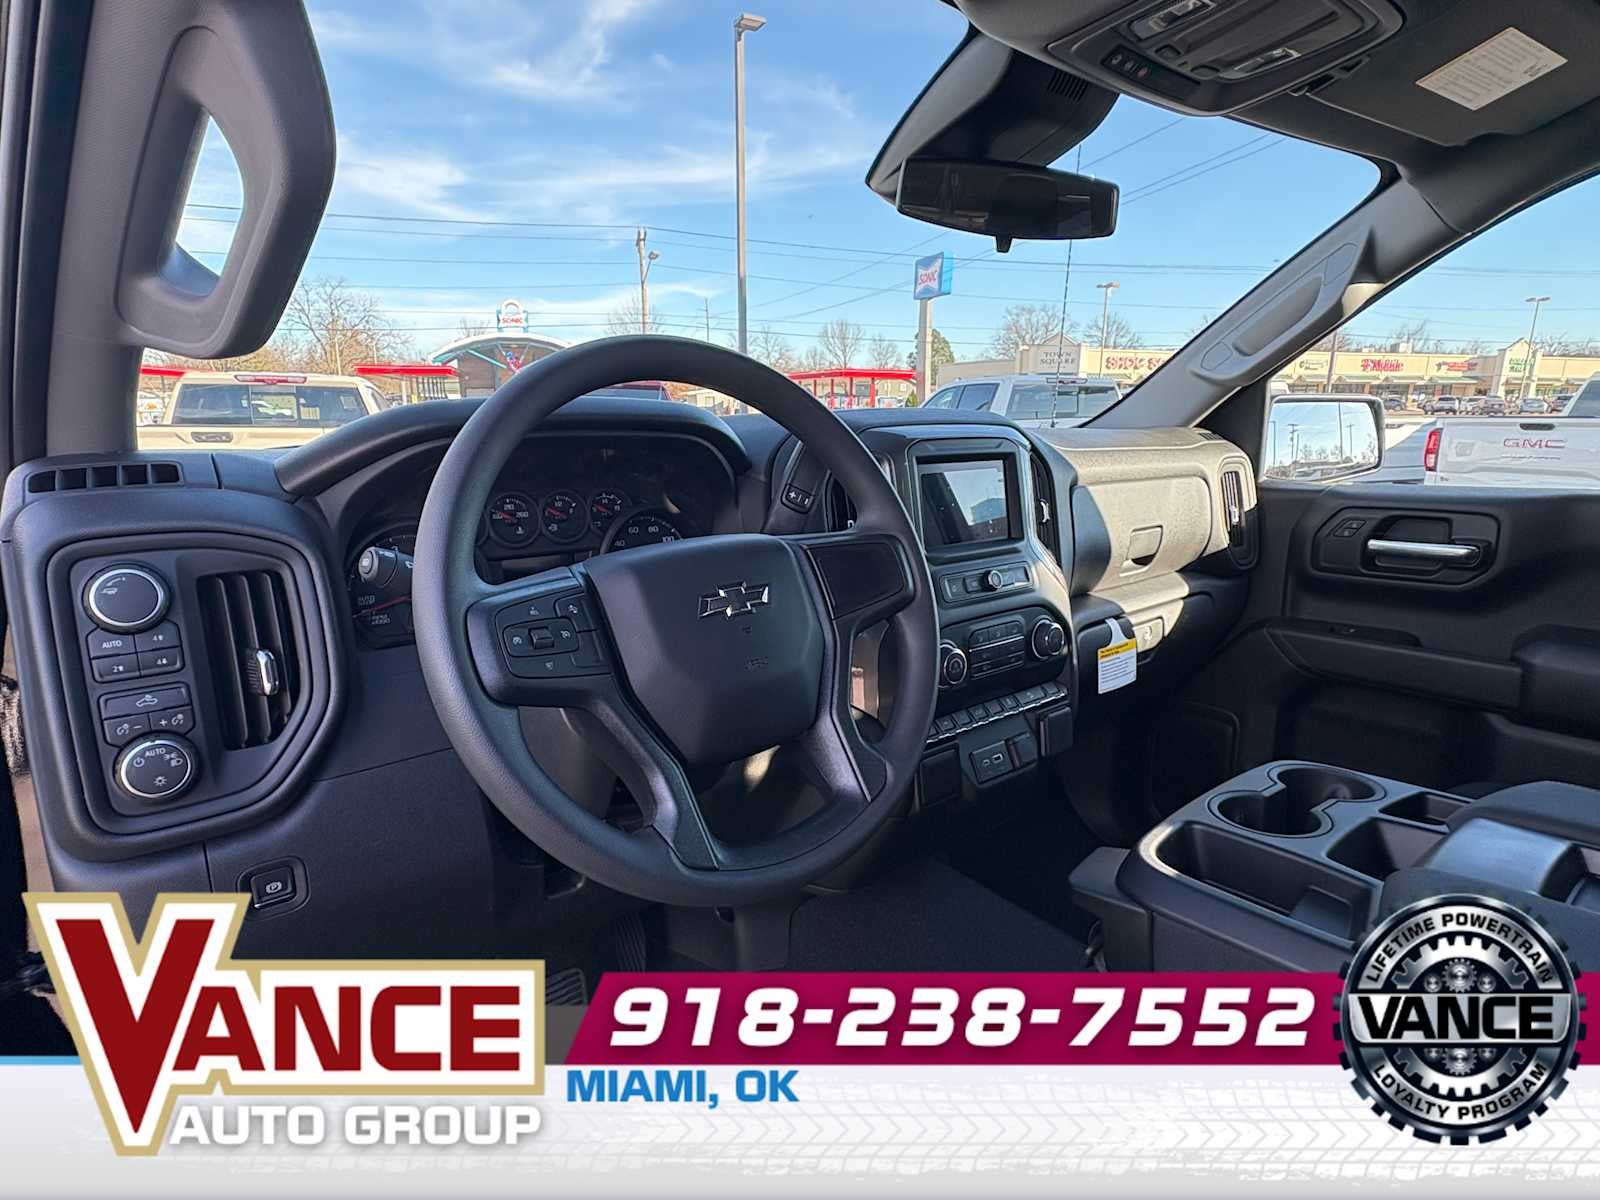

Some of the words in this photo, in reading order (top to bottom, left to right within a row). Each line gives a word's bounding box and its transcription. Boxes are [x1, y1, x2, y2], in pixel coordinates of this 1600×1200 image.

[1503, 438, 1566, 449] GMC
[102, 639, 122, 649] AUTO
[145, 747, 166, 757] AUTO
